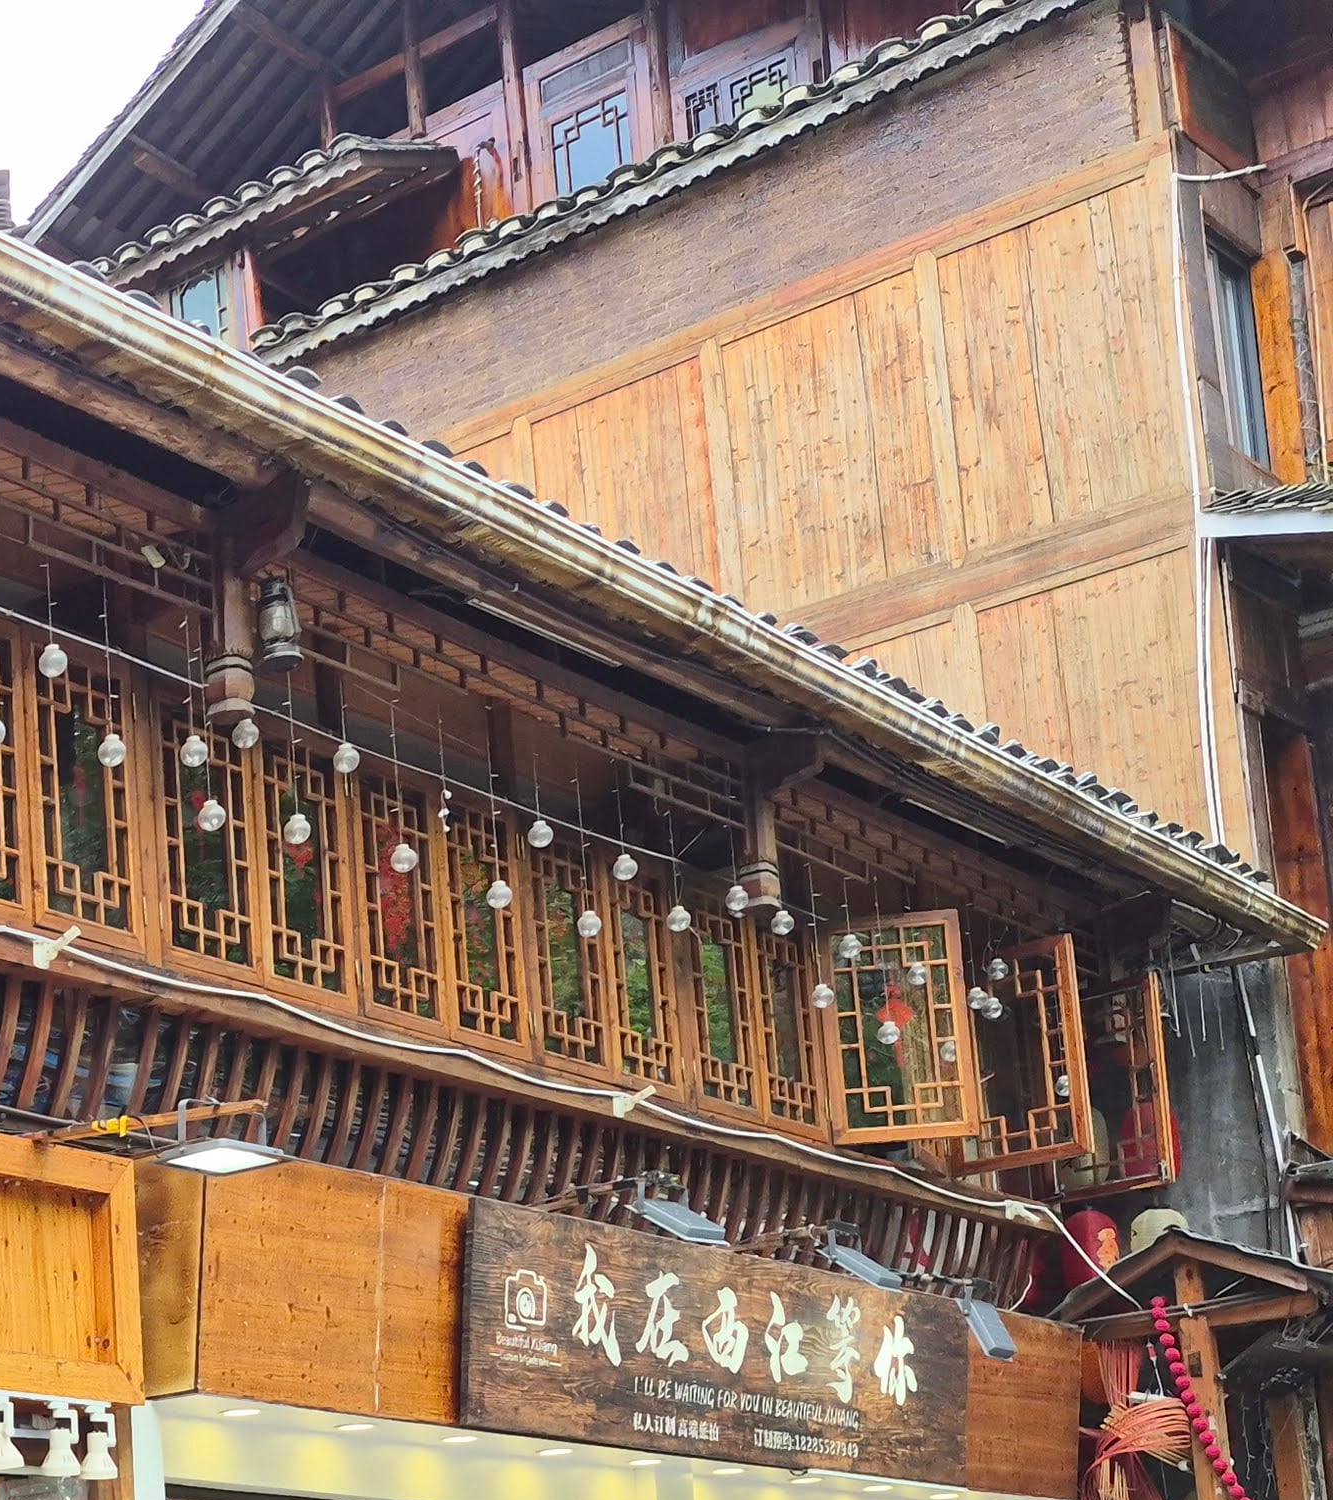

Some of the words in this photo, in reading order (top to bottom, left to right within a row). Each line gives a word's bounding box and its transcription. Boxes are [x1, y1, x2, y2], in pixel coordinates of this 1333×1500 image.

[572, 1243, 917, 1406] 我在西江等你
[657, 1379, 672, 1399] BE
[674, 1381, 715, 1408] WAITING
[717, 1390, 737, 1409] FOR
[739, 1393, 760, 1412] YOU
[762, 1395, 774, 1415] IN
[774, 1398, 823, 1422] BEAUTIFUL
